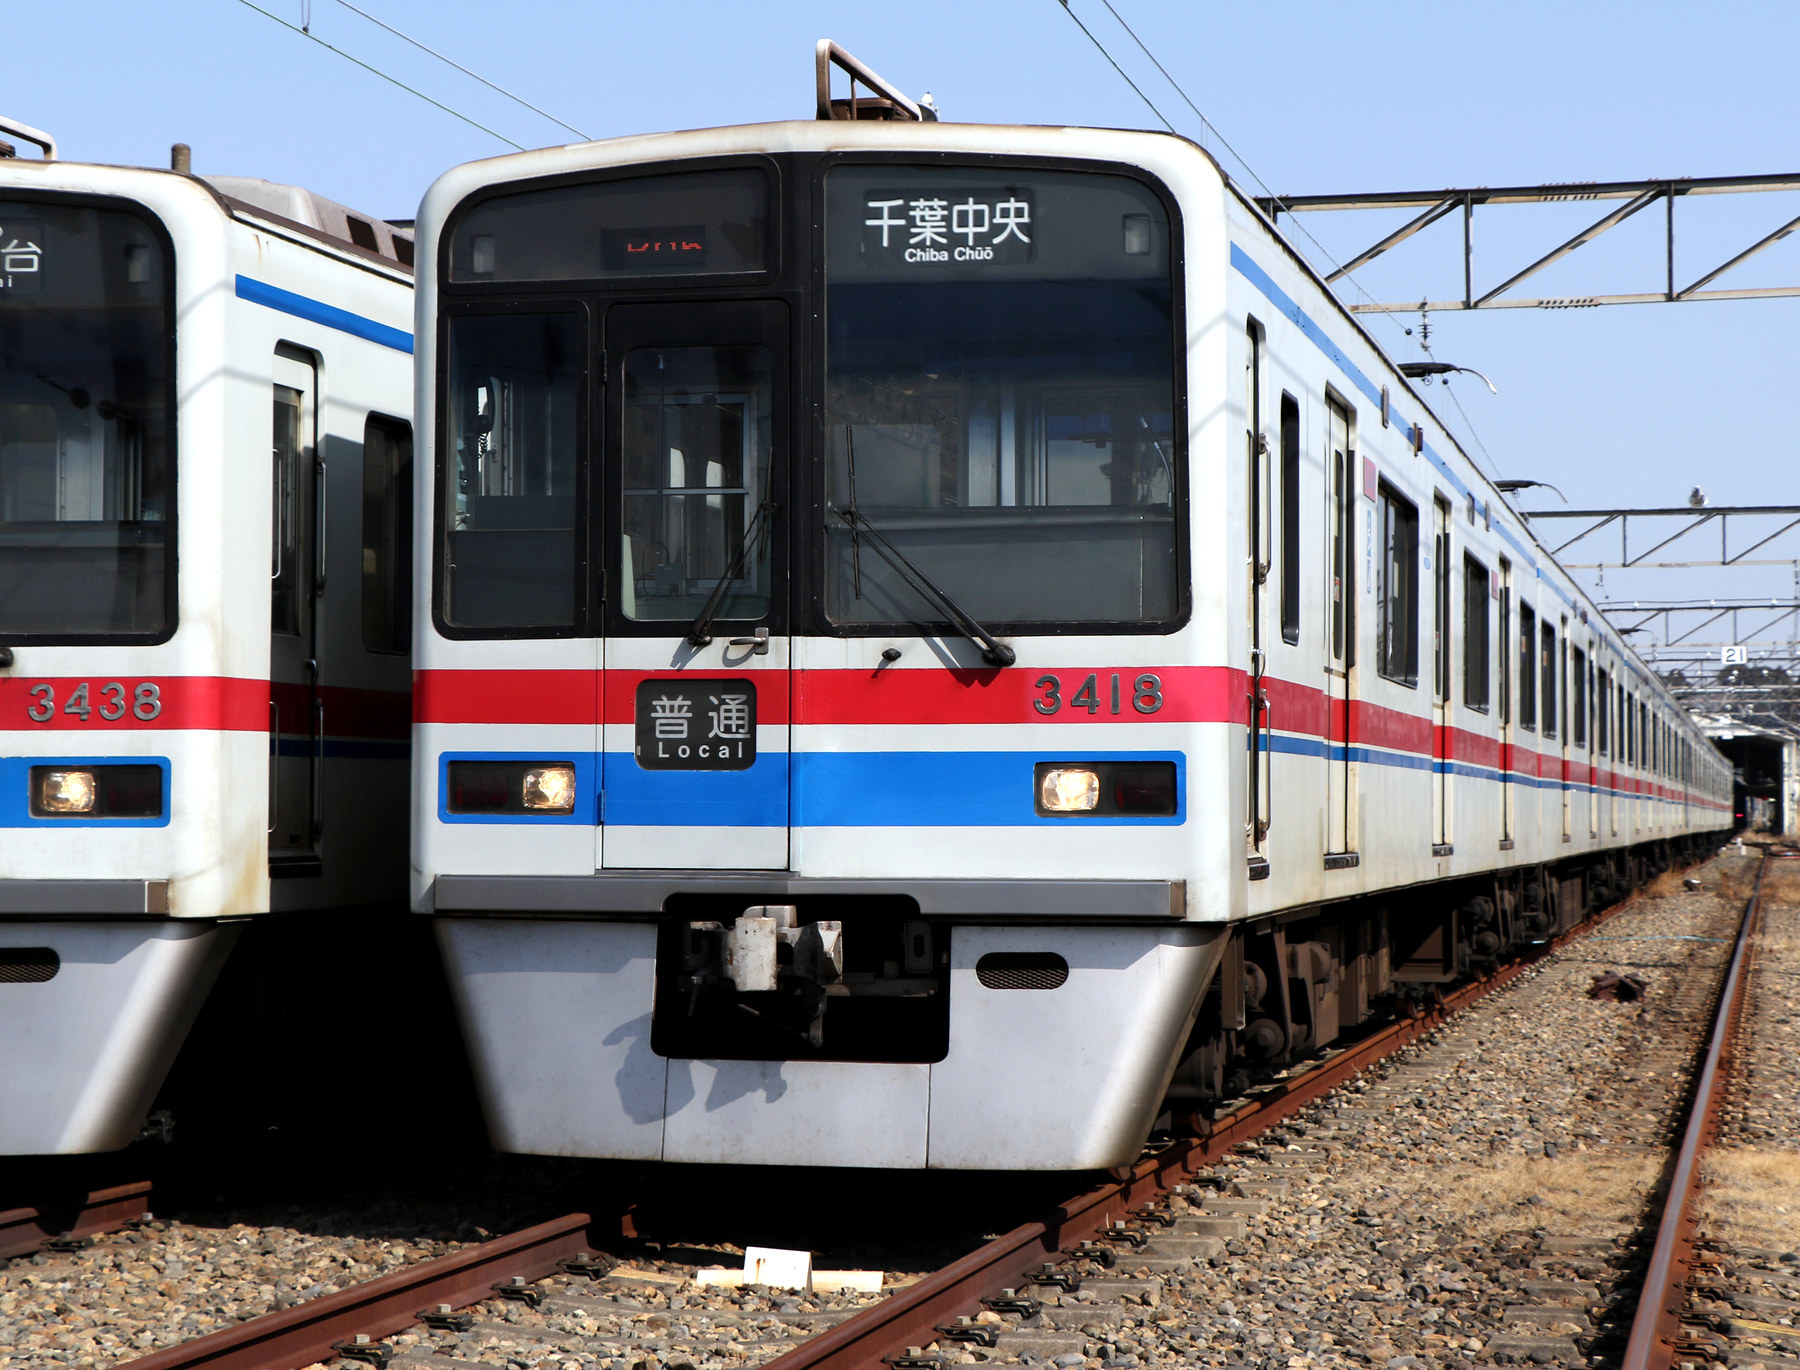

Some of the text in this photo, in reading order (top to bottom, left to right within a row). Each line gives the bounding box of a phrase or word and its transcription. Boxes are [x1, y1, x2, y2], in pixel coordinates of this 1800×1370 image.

[865, 197, 1031, 247] 千葉中央
[0, 227, 42, 272] 台
[905, 247, 994, 262] Chiba Chūō
[1726, 648, 1743, 662] 21
[28, 682, 161, 722] 3438
[1034, 673, 1163, 714] 3418
[651, 694, 751, 739] 普通
[658, 741, 742, 758] Local
